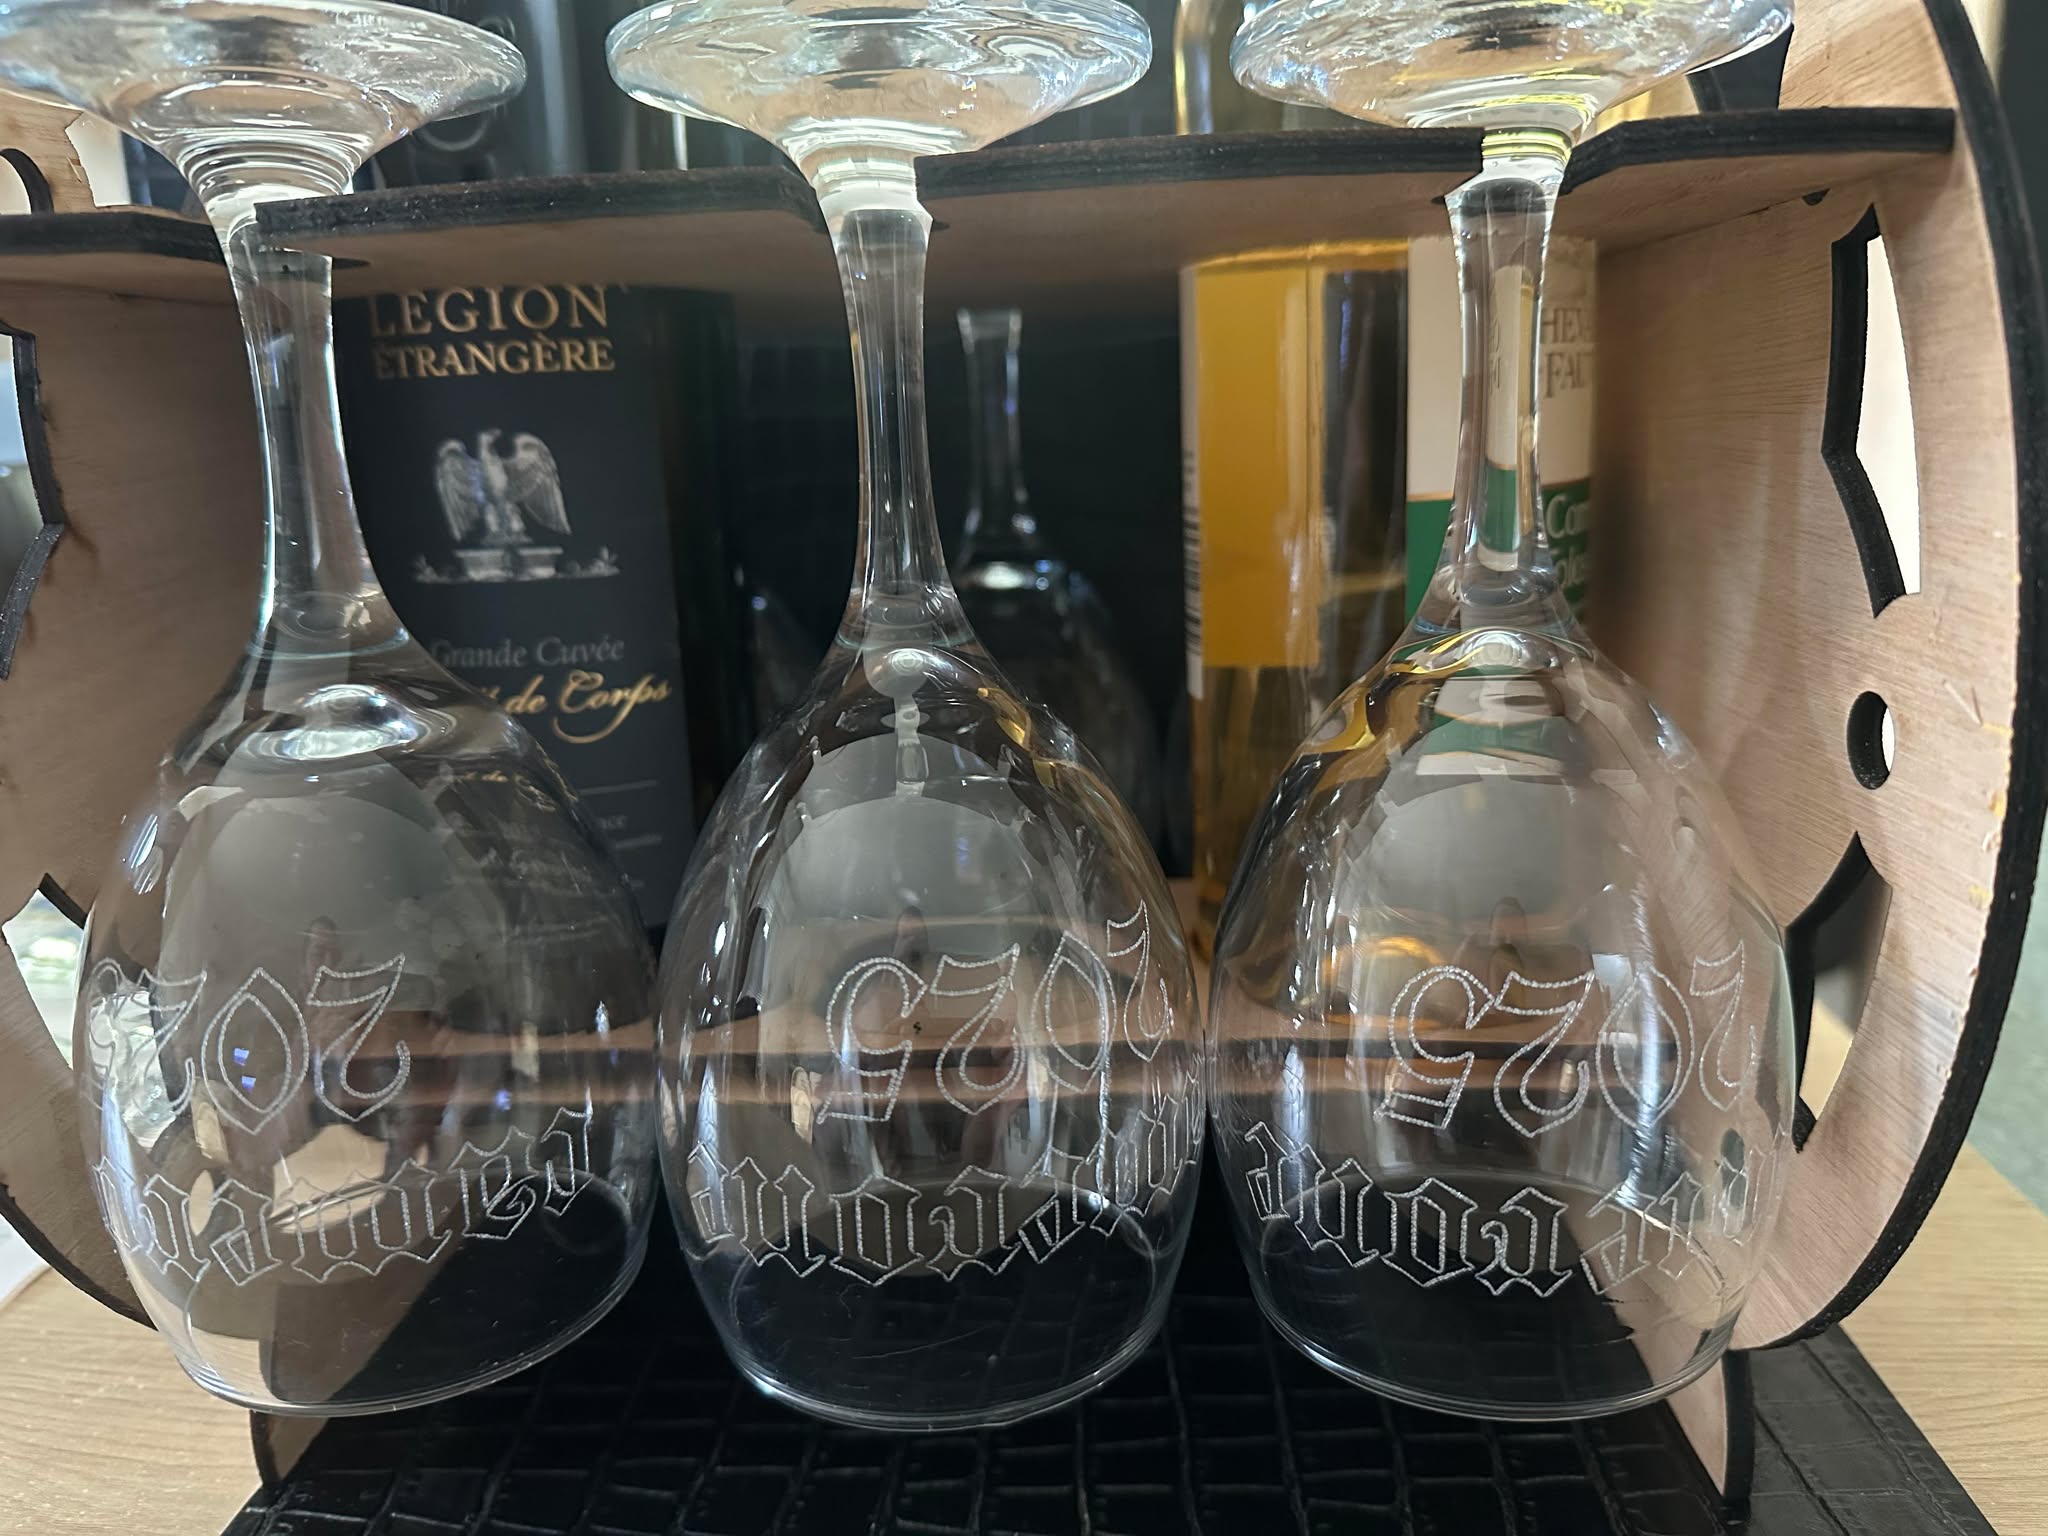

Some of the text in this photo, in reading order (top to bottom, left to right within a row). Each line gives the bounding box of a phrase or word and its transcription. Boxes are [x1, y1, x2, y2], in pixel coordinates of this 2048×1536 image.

[504, 669, 672, 744] de Corps
[536, 635, 626, 667] Cuvée
[816, 899, 1174, 1125] 2025
[1373, 940, 1758, 1139] 2025
